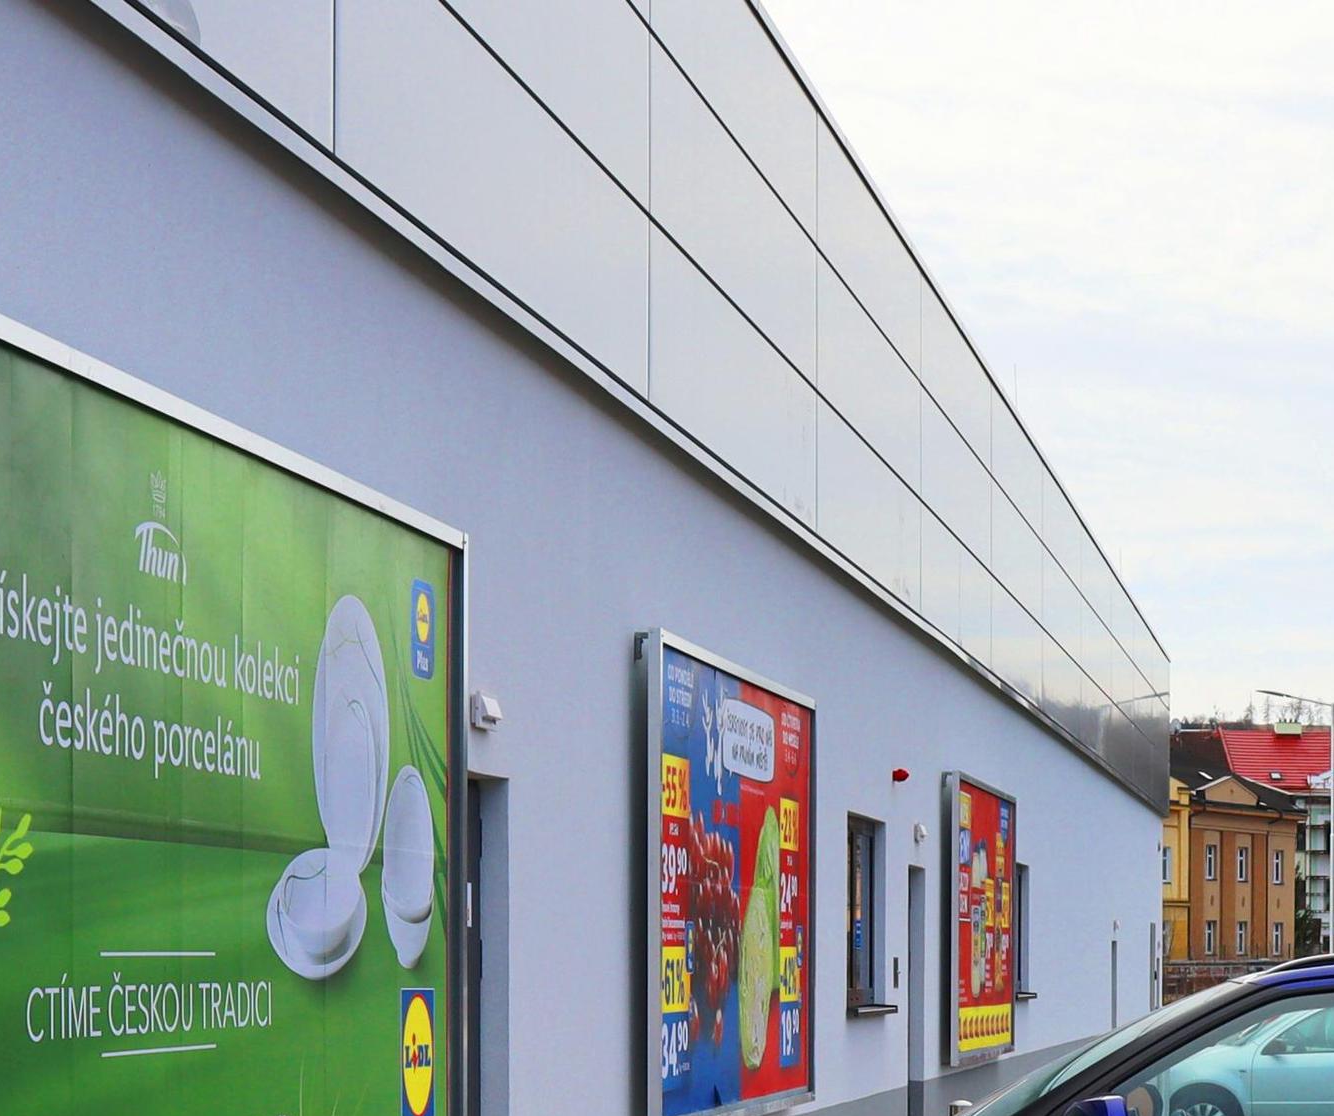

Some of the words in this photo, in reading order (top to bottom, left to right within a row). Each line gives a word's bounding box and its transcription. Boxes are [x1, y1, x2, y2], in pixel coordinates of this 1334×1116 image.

[95, 596, 227, 689] jedinečnou
[234, 633, 300, 705] kolekci
[38, 680, 146, 761] českého
[153, 715, 261, 780] porcelánu
[26, 972, 103, 1042] CTÍME
[108, 972, 194, 1037] ČESKOU
[199, 980, 273, 1030] TRADICI
[404, 1033, 431, 1073] LIDL
